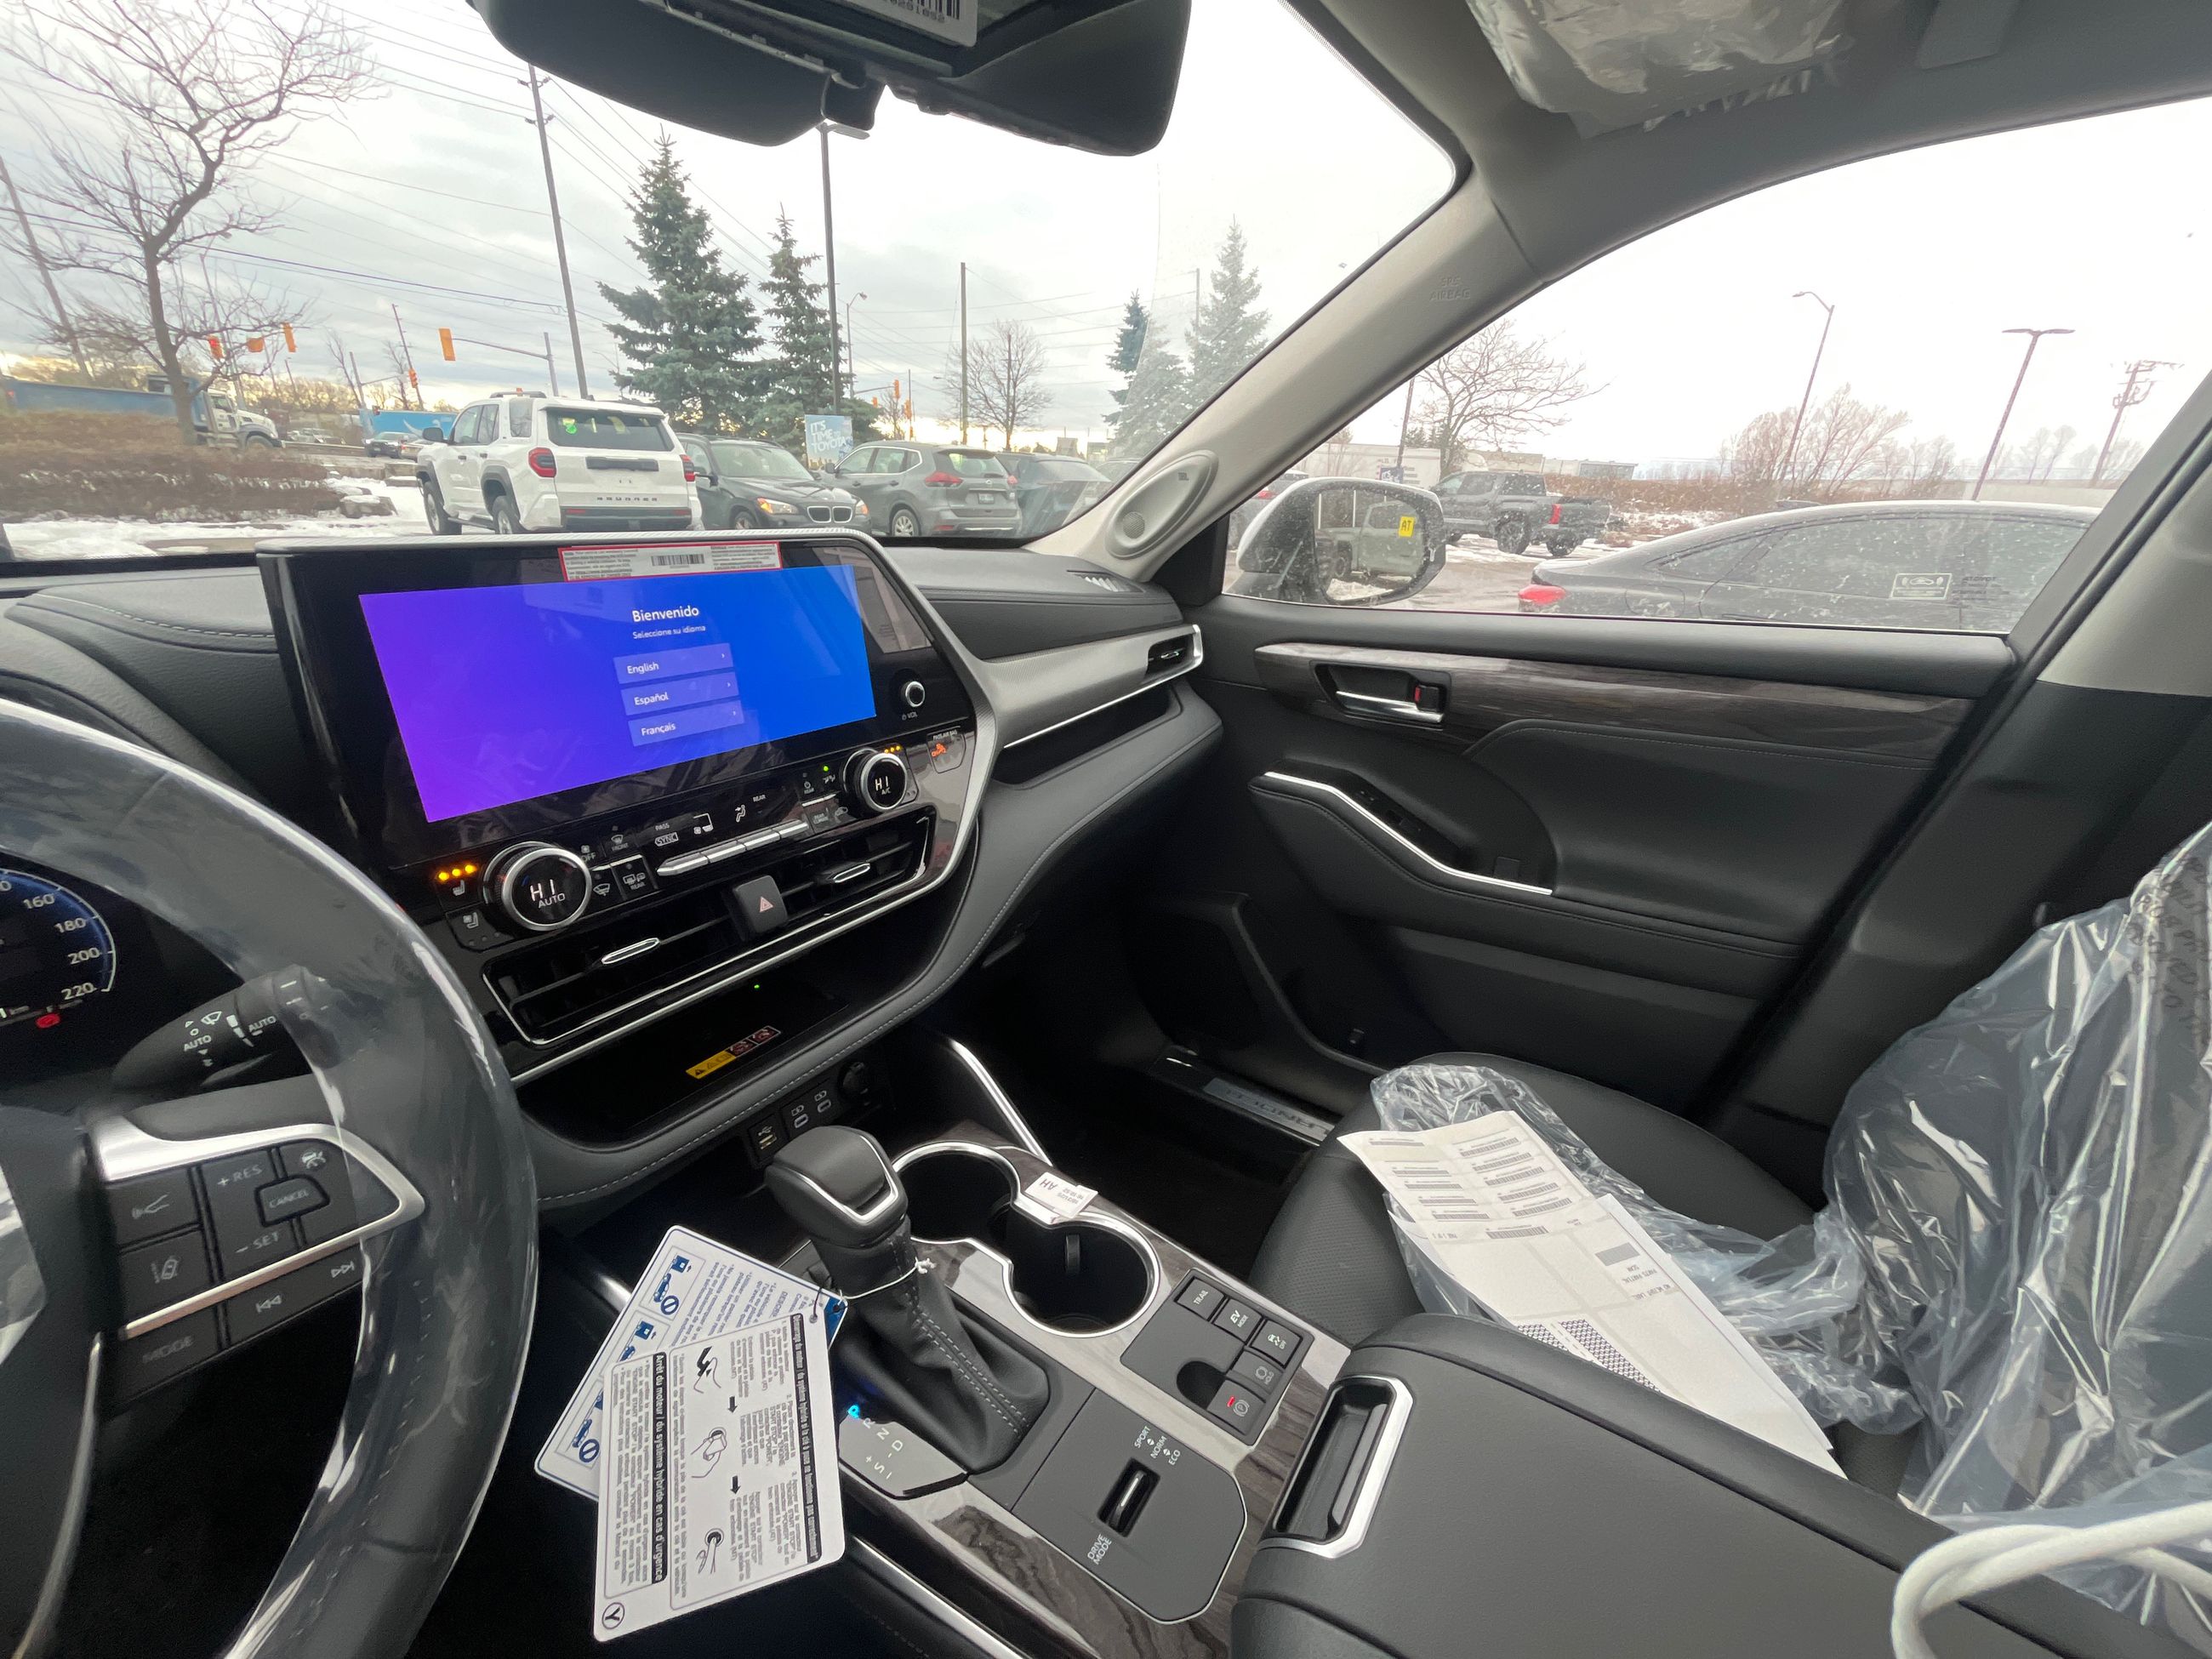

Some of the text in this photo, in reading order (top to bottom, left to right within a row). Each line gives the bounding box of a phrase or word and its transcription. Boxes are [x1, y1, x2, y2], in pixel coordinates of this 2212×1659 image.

[810, 420, 826, 434] IT'S
[812, 429, 833, 442] TIME
[812, 436, 847, 453] TOYOTA
[1401, 521, 1411, 531] AT
[632, 605, 699, 622] Bienvenido
[633, 630, 671, 639] Seleccione
[683, 624, 705, 634] idioma
[627, 662, 658, 675] English
[634, 692, 669, 705] Español
[641, 722, 676, 736] Français
[875, 776, 888, 791] HI
[657, 834, 677, 846] SYNC
[581, 852, 596, 863] OFF
[530, 879, 555, 902] HI
[23, 893, 55, 909] 160
[539, 892, 565, 908] AUTO
[54, 917, 87, 933] 180
[68, 947, 100, 965] 200
[61, 982, 94, 1001] 220
[248, 1016, 276, 1032] AUTO
[184, 1035, 212, 1052] AUTO
[1038, 1177, 1058, 1193] AH
[269, 1190, 310, 1208] CANCEL
[1193, 1290, 1209, 1305] TRAIL
[1230, 1309, 1240, 1324] EV
[142, 1336, 194, 1362] MODE
[656, 1374, 664, 1386] du
[847, 1405, 860, 1419] P
[656, 1420, 664, 1432] du
[863, 1417, 875, 1428] R
[876, 1427, 890, 1440] N
[1134, 1425, 1151, 1449] SPORT
[653, 1433, 664, 1469] système
[891, 1440, 904, 1451] D
[1150, 1435, 1167, 1459] NORM
[1168, 1449, 1181, 1466] ECO
[874, 1462, 886, 1474] S
[653, 1468, 664, 1503] hybride
[655, 1502, 664, 1515] en
[655, 1515, 664, 1533] cas
[1086, 1533, 1107, 1560] DRIVE
[1093, 1536, 1113, 1565] MODE
[653, 1533, 664, 1582] d'urgence
[605, 1605, 620, 1625] Y
